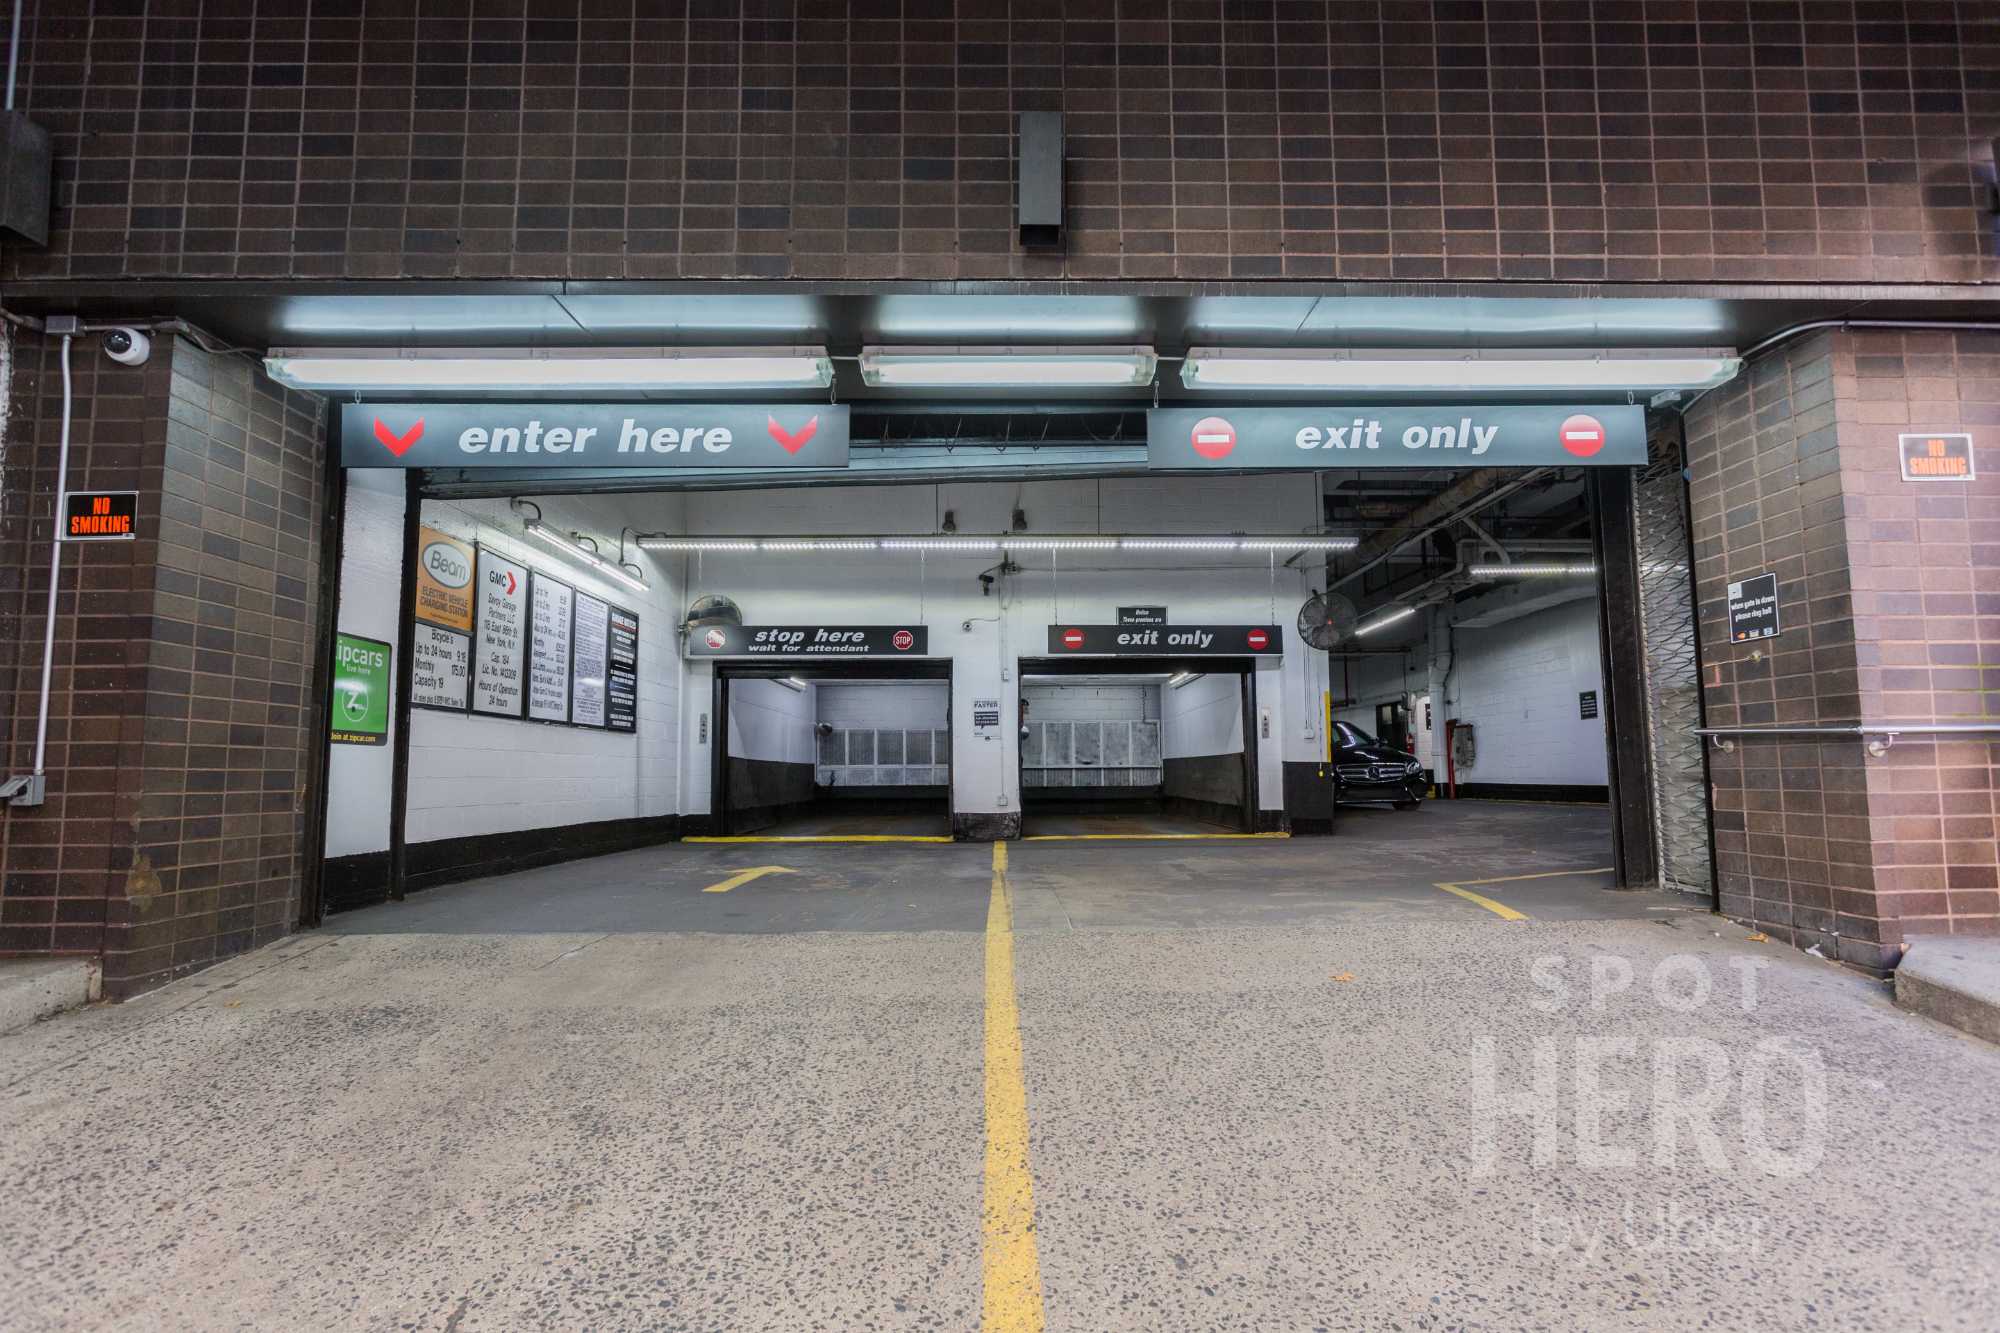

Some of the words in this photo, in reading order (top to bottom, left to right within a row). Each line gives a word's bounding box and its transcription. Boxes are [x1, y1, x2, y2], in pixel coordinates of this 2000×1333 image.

[458, 420, 597, 453] enter
[617, 418, 733, 452] here
[1295, 418, 1382, 449] exit
[1402, 418, 1498, 455] only
[1928, 440, 1945, 456] NO
[1910, 457, 1967, 474] SMOKING
[94, 497, 110, 514] NO
[72, 516, 130, 534] SMOKING
[431, 550, 466, 580] Beam
[489, 570, 506, 587] GMC
[422, 586, 448, 602] ELECTRIC
[1736, 612, 1752, 622] please
[754, 628, 804, 647] stop
[814, 628, 864, 642] here
[895, 636, 912, 646] STOP
[1117, 630, 1159, 645] exit
[1168, 630, 1214, 650] only
[337, 640, 382, 668] ipcars
[416, 641, 422, 654] Up
[431, 644, 438, 656] 24
[439, 648, 452, 660] hours
[748, 644, 776, 652] wait
[782, 644, 800, 652] for
[806, 644, 870, 652] attendant
[415, 656, 434, 674] Monthly
[414, 672, 436, 690] Capacity
